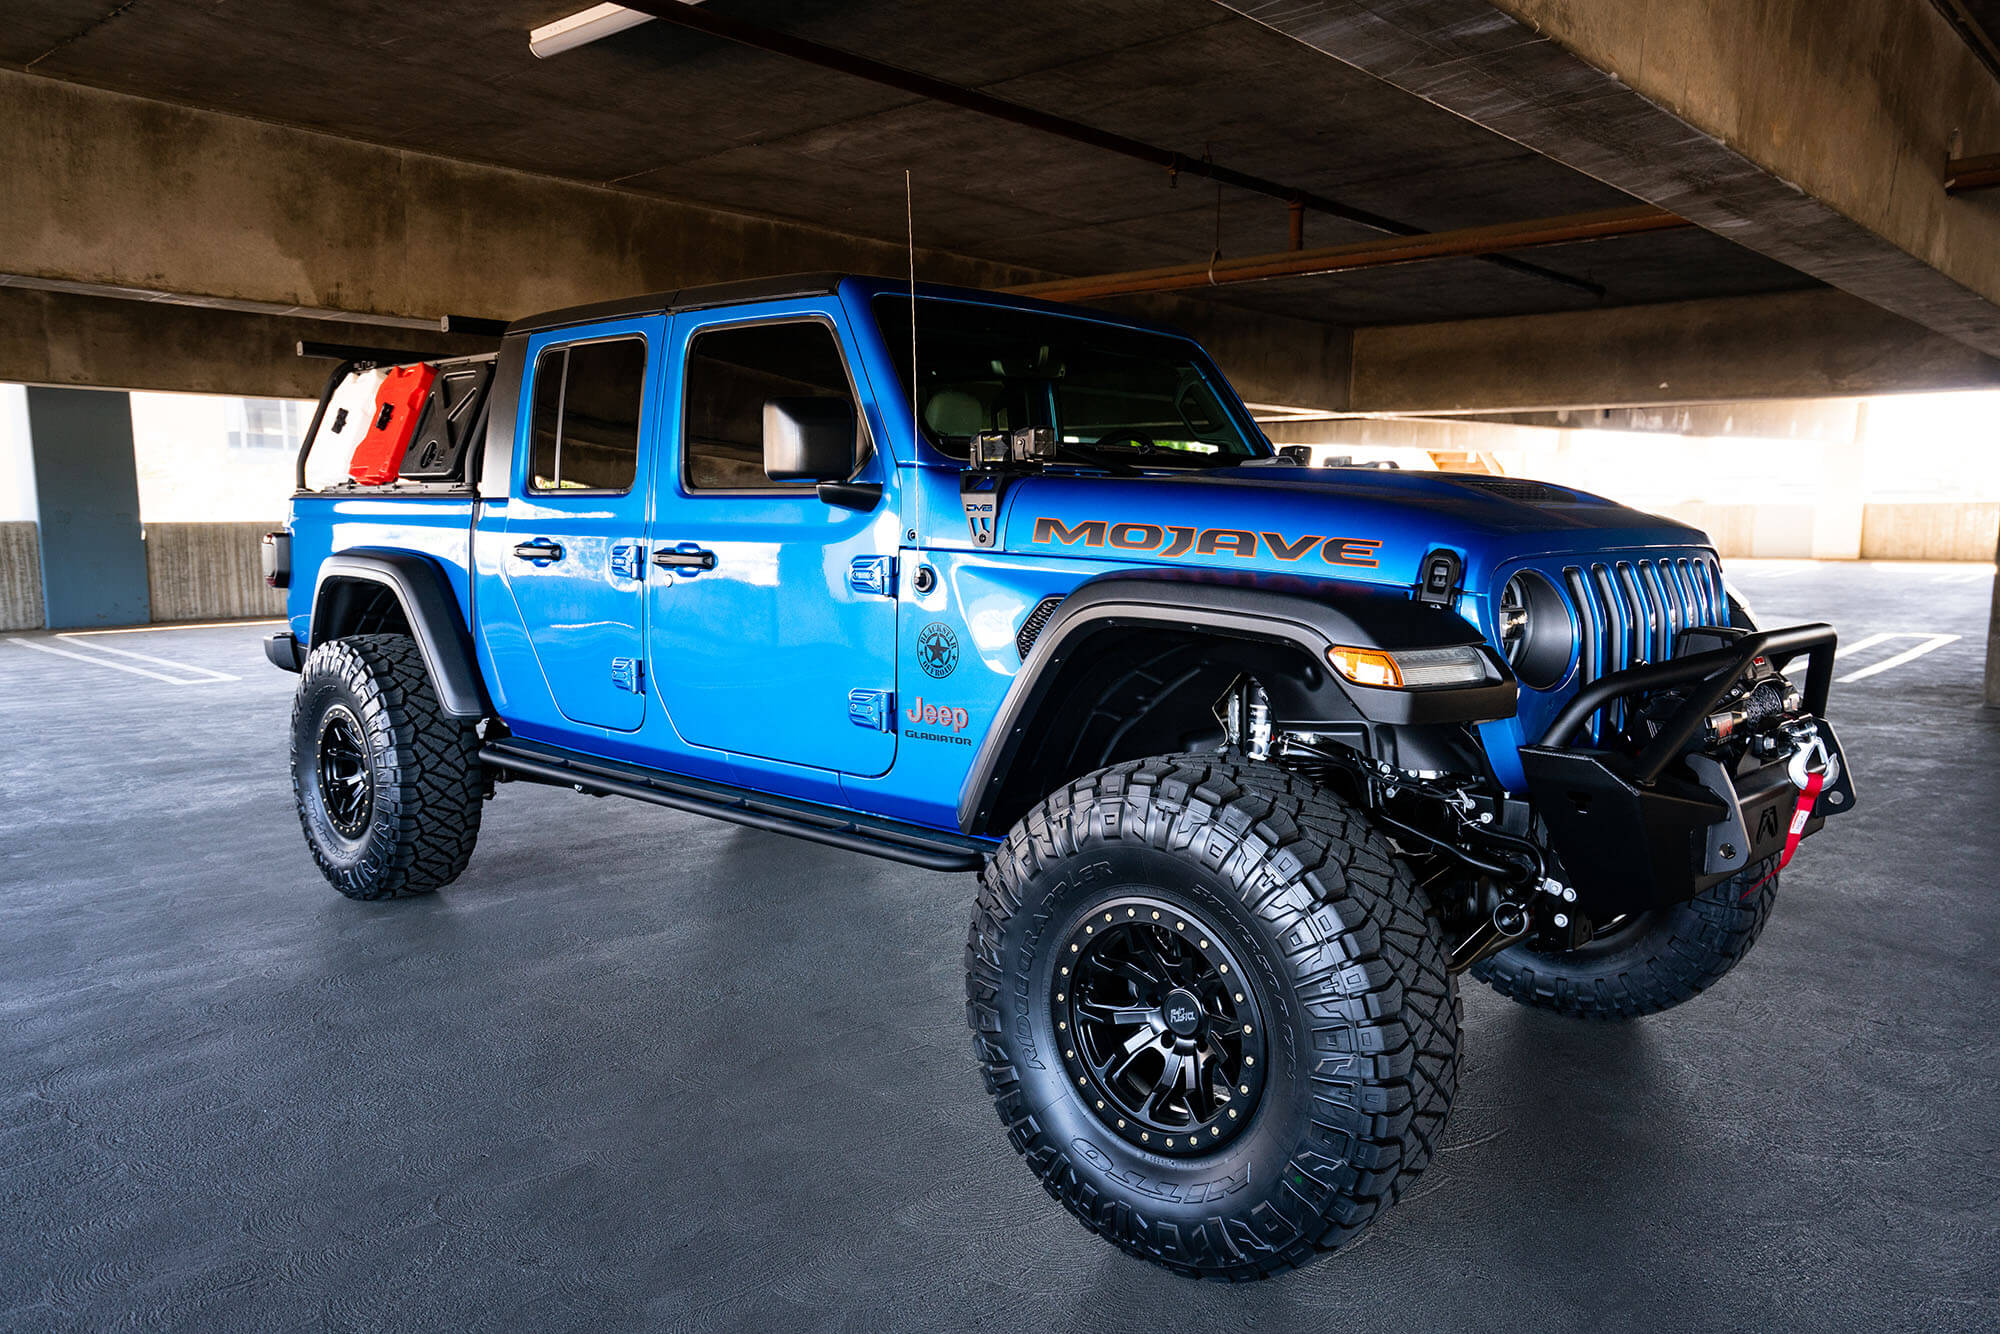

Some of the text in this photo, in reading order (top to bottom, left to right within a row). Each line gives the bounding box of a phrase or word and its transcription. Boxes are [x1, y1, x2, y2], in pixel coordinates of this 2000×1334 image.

[1032, 516, 1384, 569] MOJAVE
[906, 696, 969, 733] Jeep
[904, 729, 973, 747] GLADIATOR
[1071, 1136, 1253, 1205] NITTO
